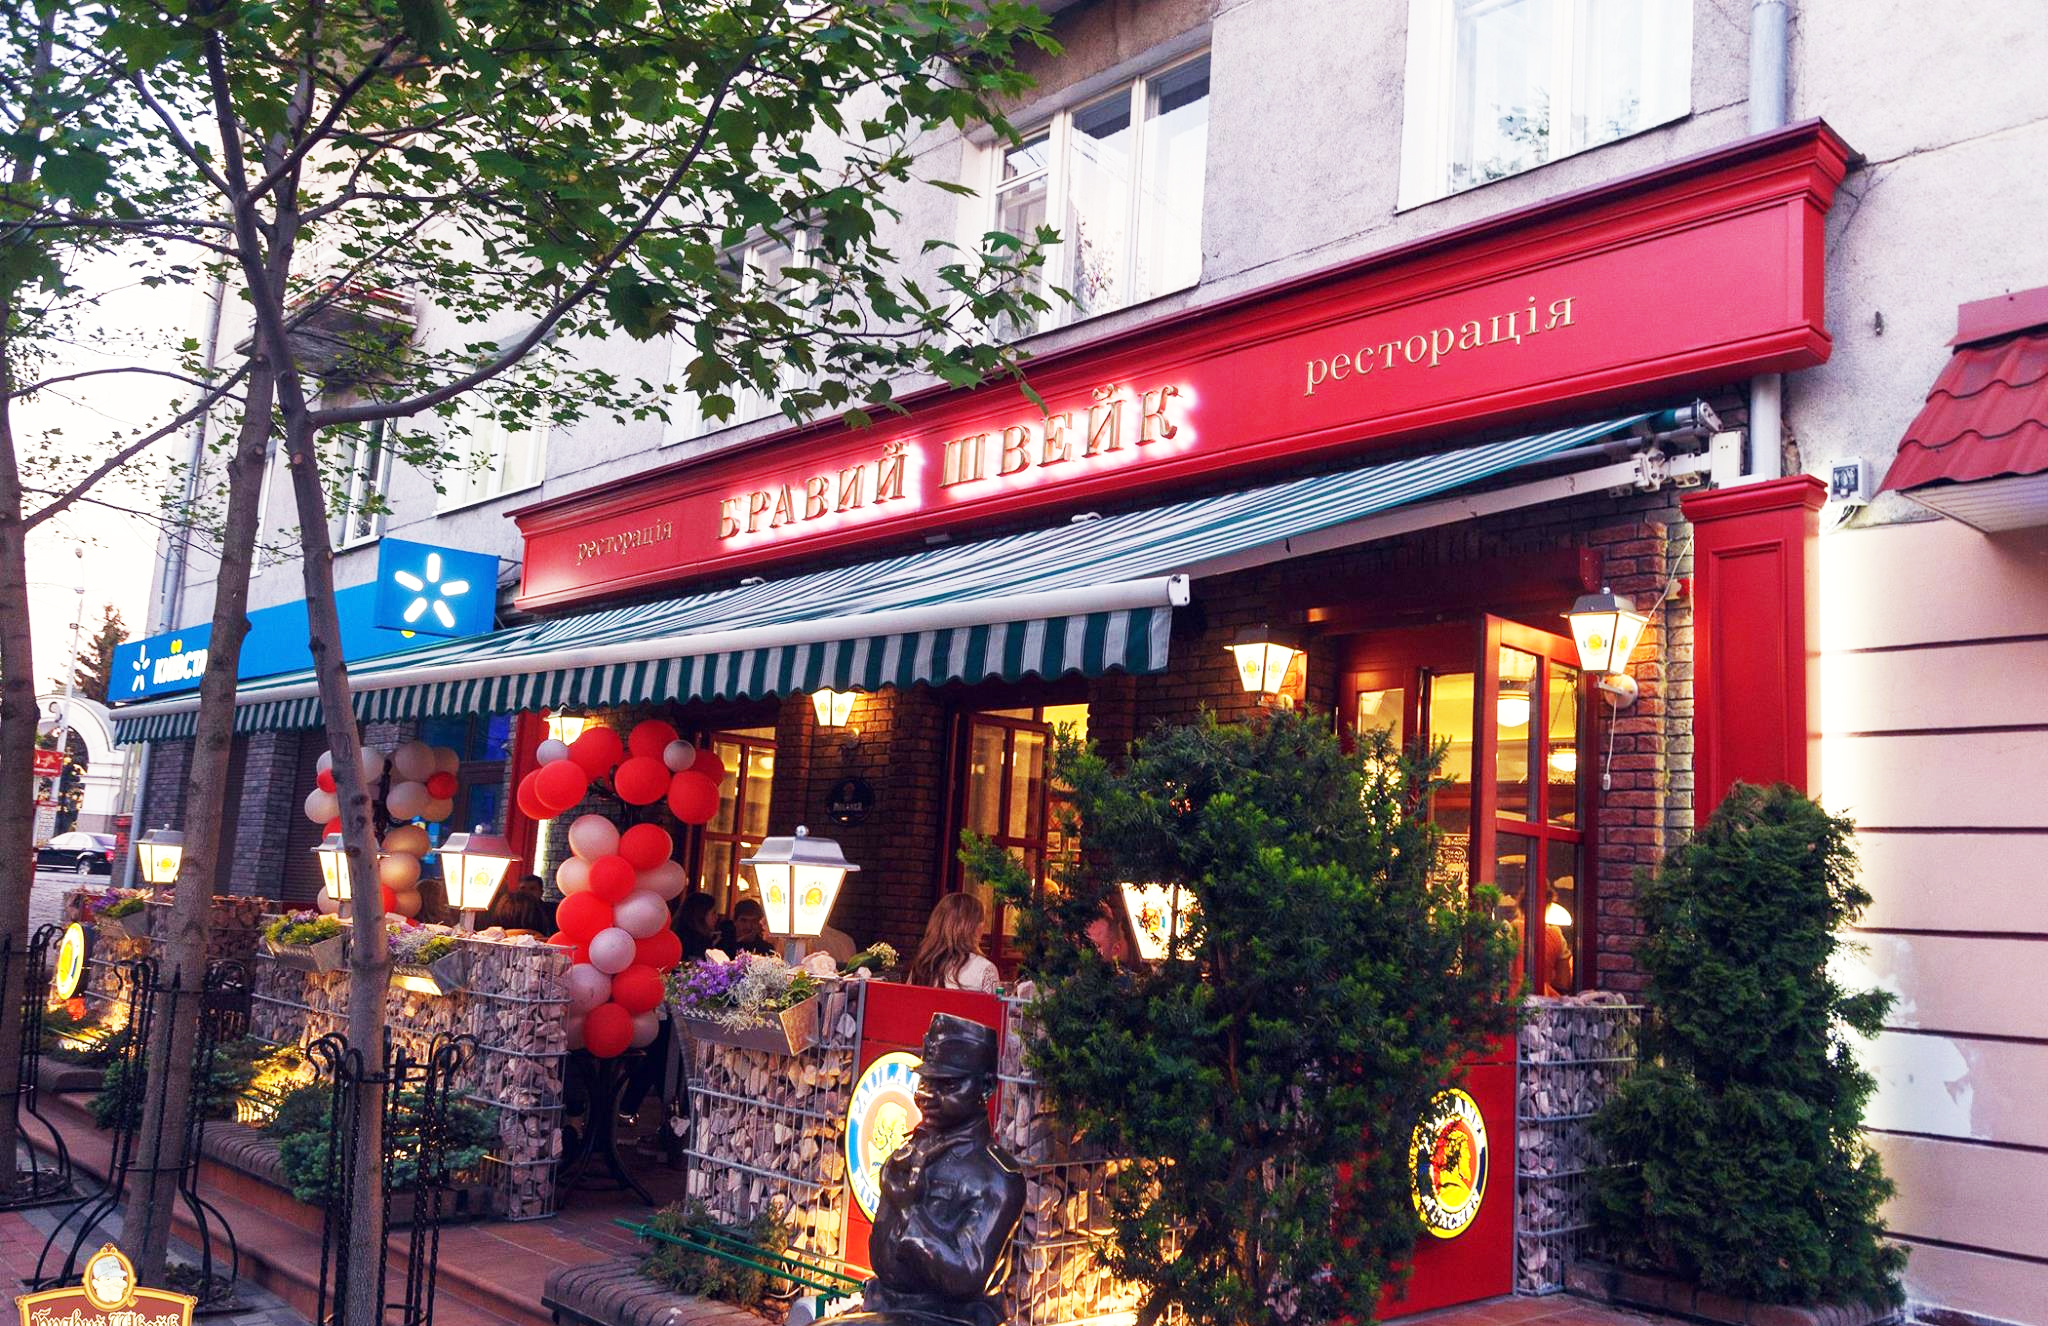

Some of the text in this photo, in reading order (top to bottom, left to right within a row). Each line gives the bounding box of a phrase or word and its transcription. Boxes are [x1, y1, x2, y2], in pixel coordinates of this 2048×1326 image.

[1305, 297, 1576, 395] ресторація
[718, 384, 1180, 539] БРАВИЙ ШВЕЙК
[577, 520, 673, 566] ресторація
